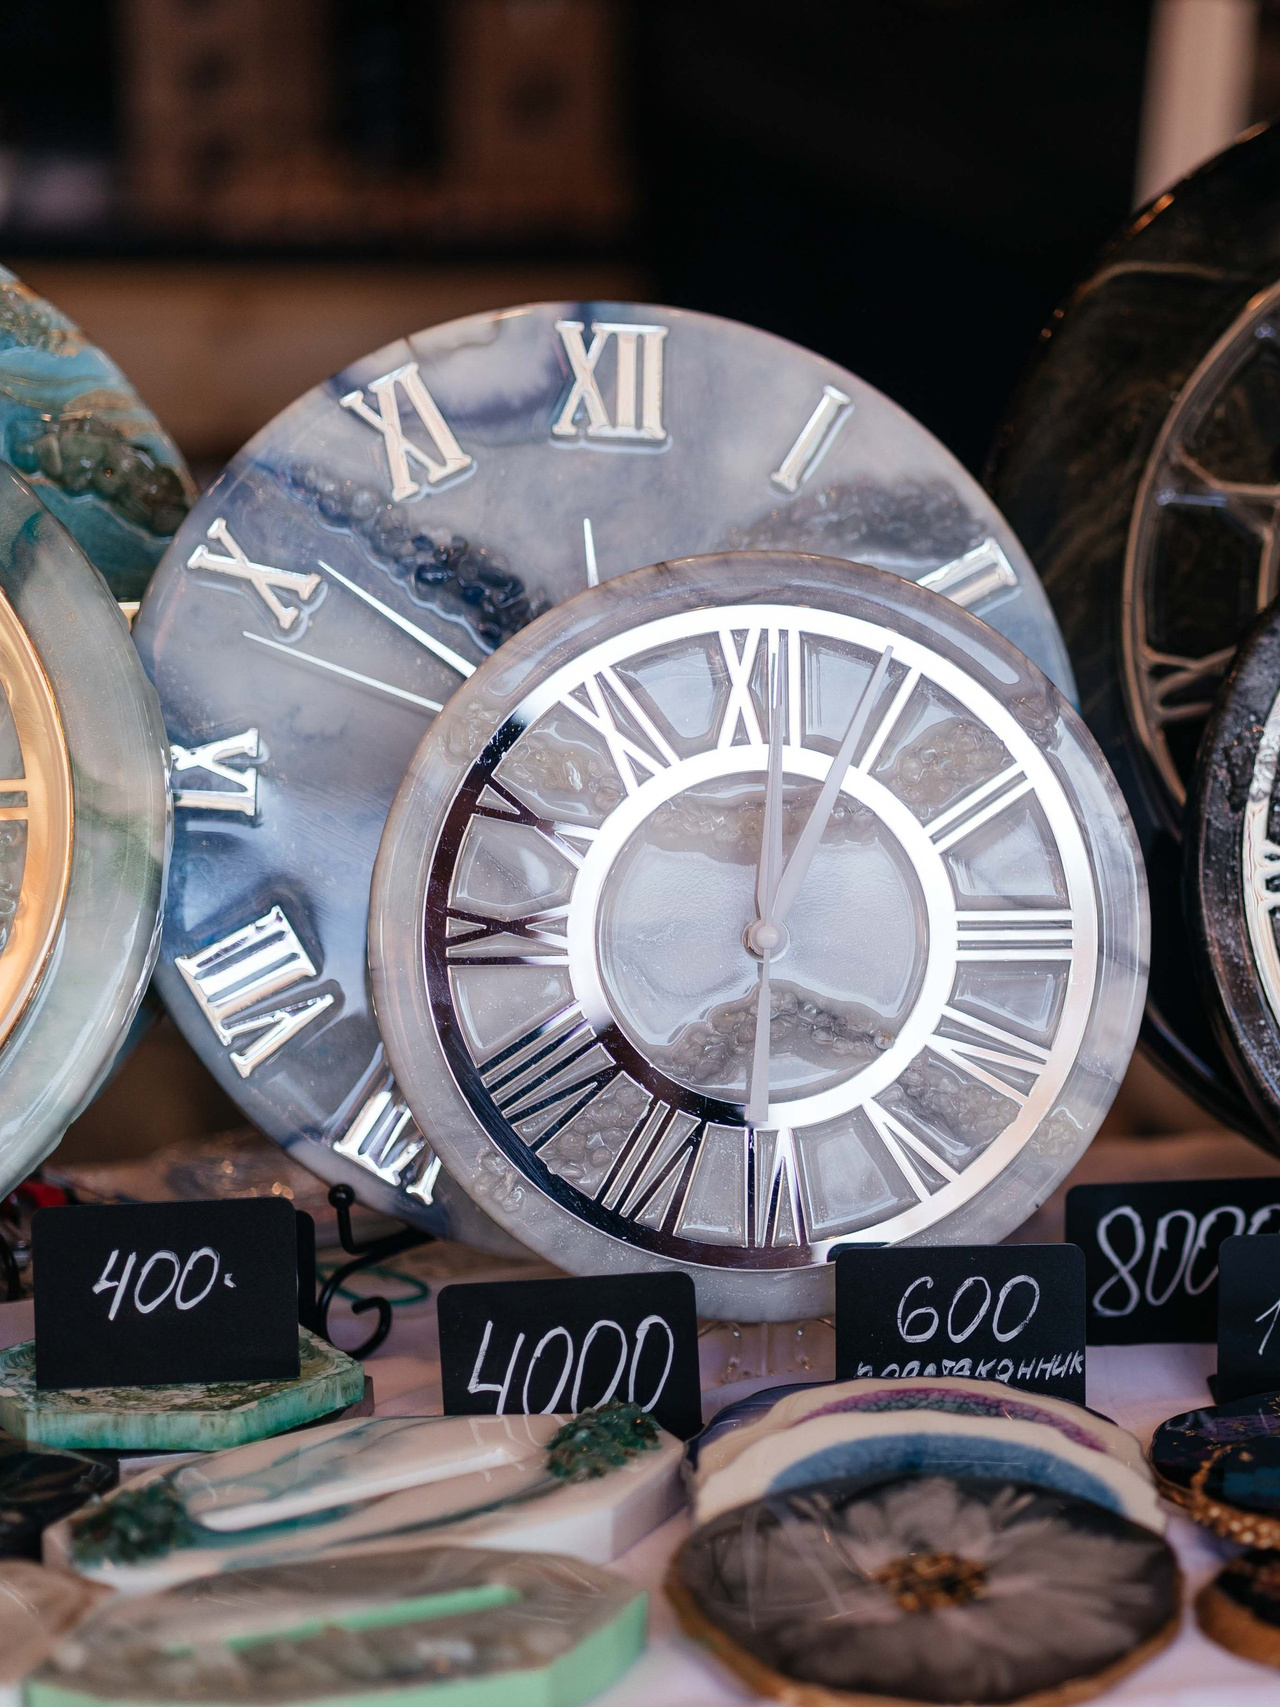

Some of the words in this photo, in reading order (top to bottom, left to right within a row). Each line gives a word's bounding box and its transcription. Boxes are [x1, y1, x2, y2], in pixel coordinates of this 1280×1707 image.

[340, 362, 472, 502] XI
[551, 319, 668, 440] XII
[770, 384, 852, 493] I
[187, 517, 322, 630] X
[466, 1314, 675, 1415] 4000
[897, 1274, 1041, 1344] 600
